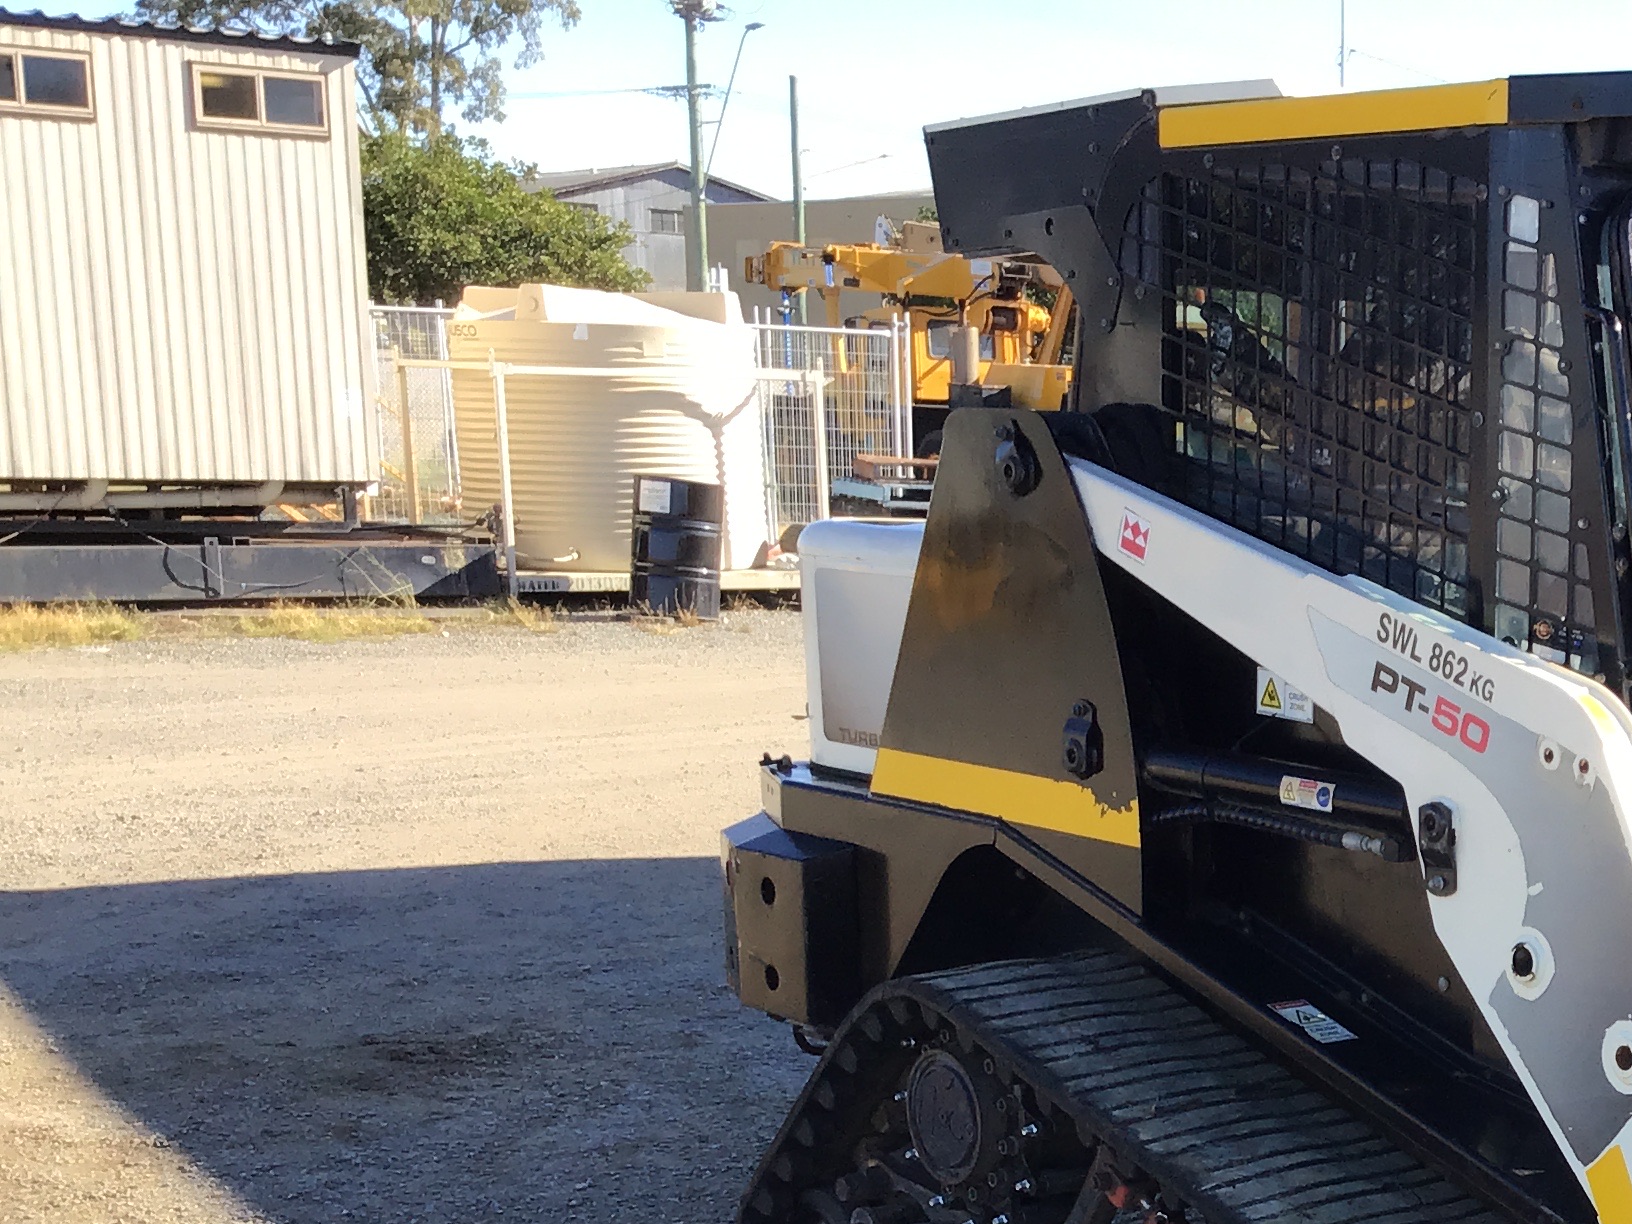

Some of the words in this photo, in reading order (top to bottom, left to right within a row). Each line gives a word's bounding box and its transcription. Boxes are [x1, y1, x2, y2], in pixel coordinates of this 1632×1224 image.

[1376, 612, 1422, 663] SWL
[1428, 642, 1468, 688] 862
[1469, 671, 1495, 703] KG
[839, 727, 879, 747] TURB
[1371, 660, 1491, 754] PT-50
